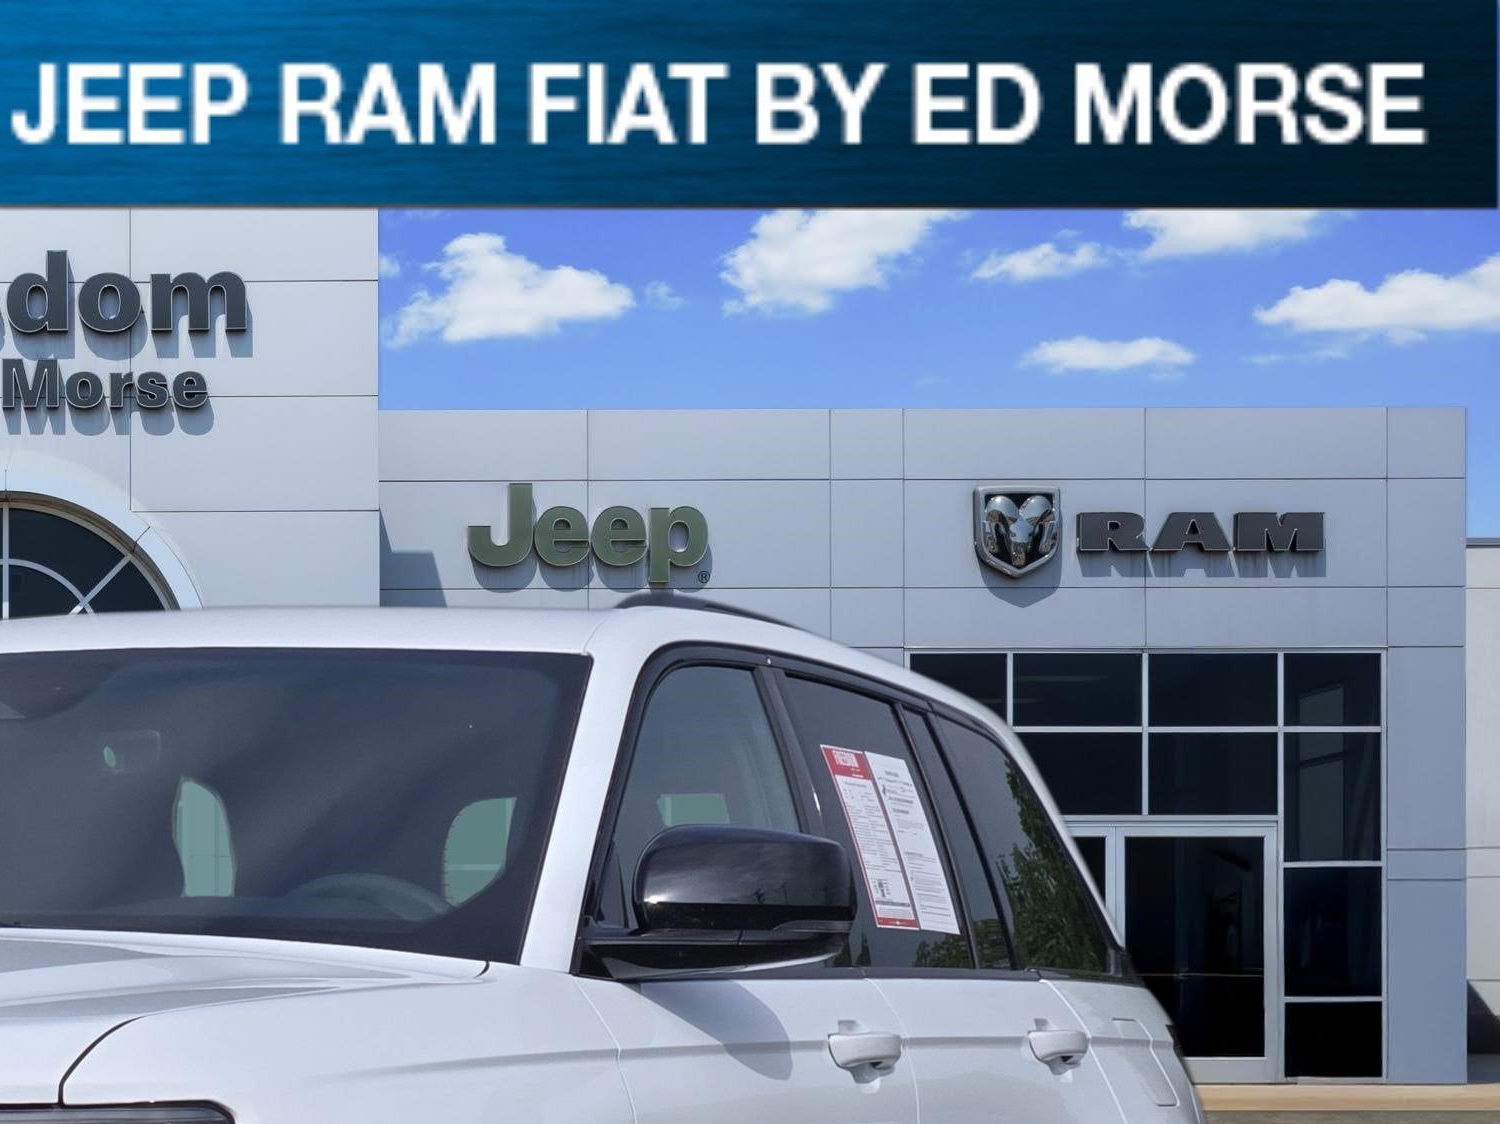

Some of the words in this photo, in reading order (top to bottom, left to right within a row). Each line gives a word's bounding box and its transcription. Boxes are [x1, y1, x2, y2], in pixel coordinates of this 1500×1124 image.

[1, 358, 209, 410] Morse
[467, 482, 709, 584] Jeep
[1076, 511, 1325, 552] RAM
